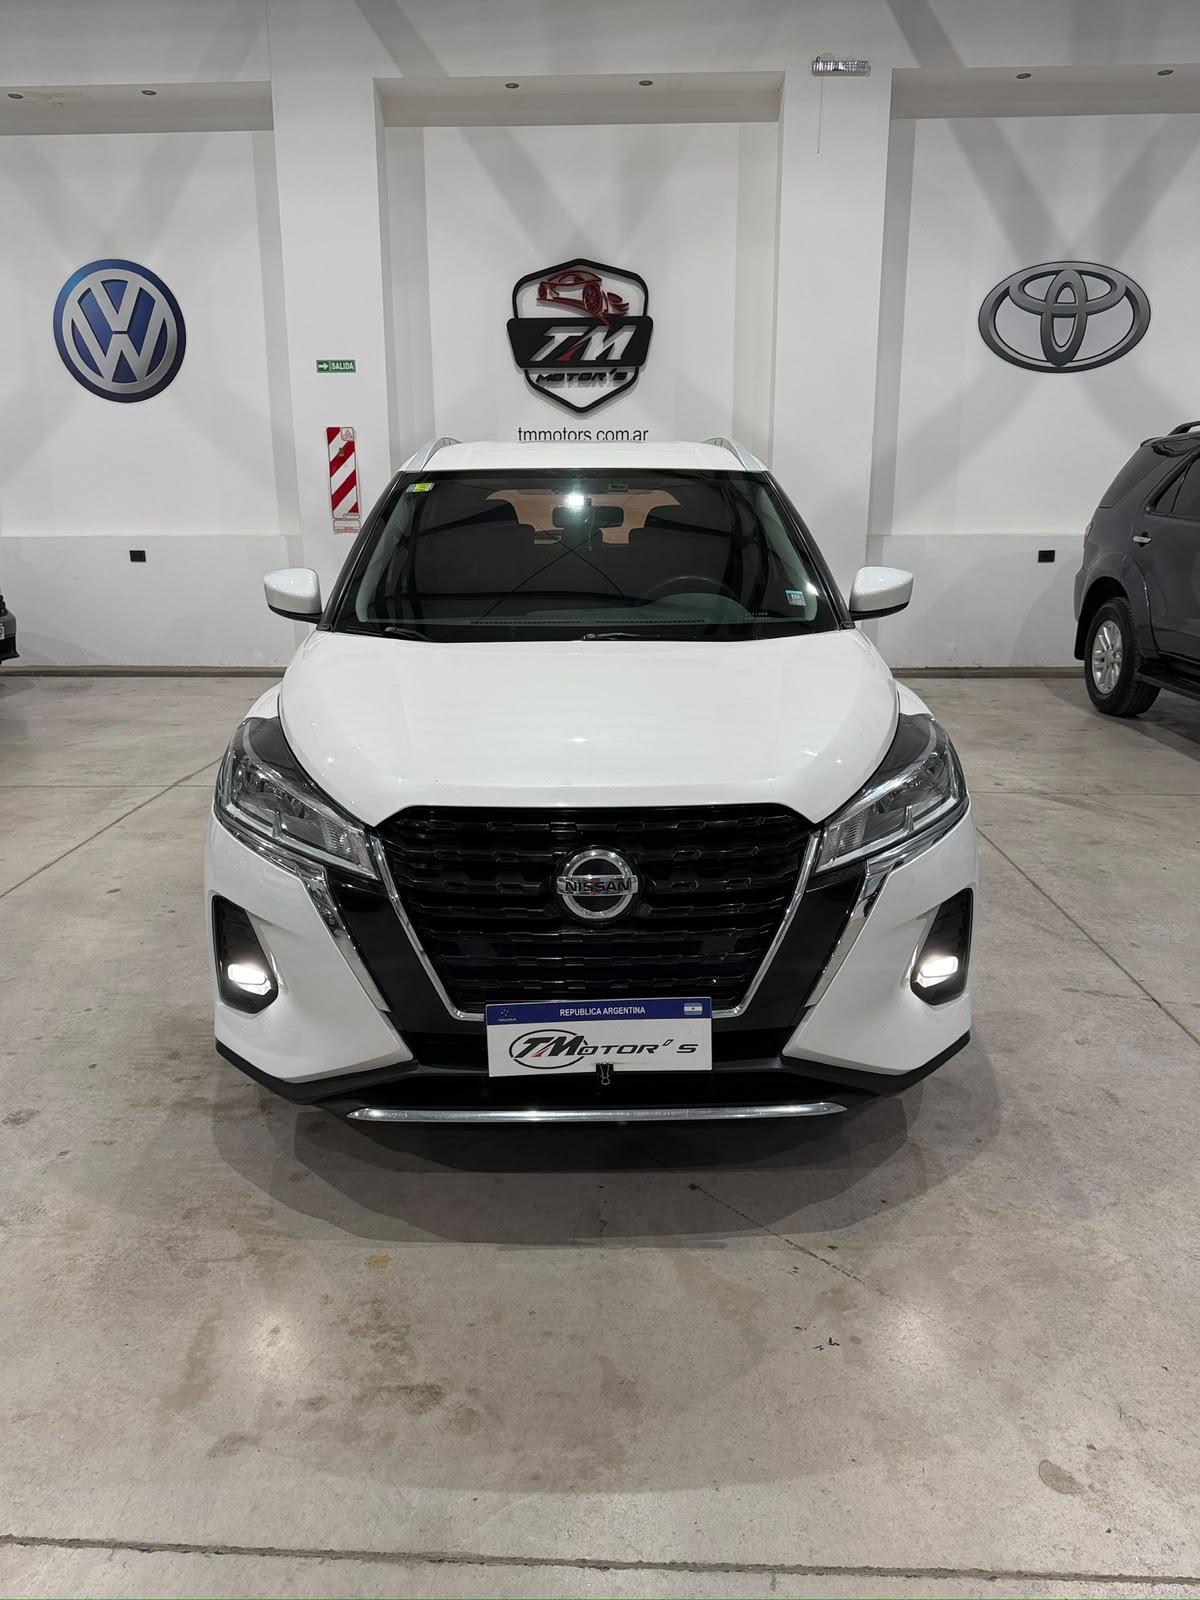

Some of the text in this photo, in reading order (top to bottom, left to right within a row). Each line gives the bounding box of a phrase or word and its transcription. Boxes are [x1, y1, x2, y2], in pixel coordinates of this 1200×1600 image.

[529, 325, 637, 362] TM
[331, 362, 354, 370] SALIDA
[518, 427, 649, 441] tmmotorscom.ar
[565, 878, 632, 893] NISSAN
[559, 1006, 646, 1017] REPUBLICA ARGENTINA
